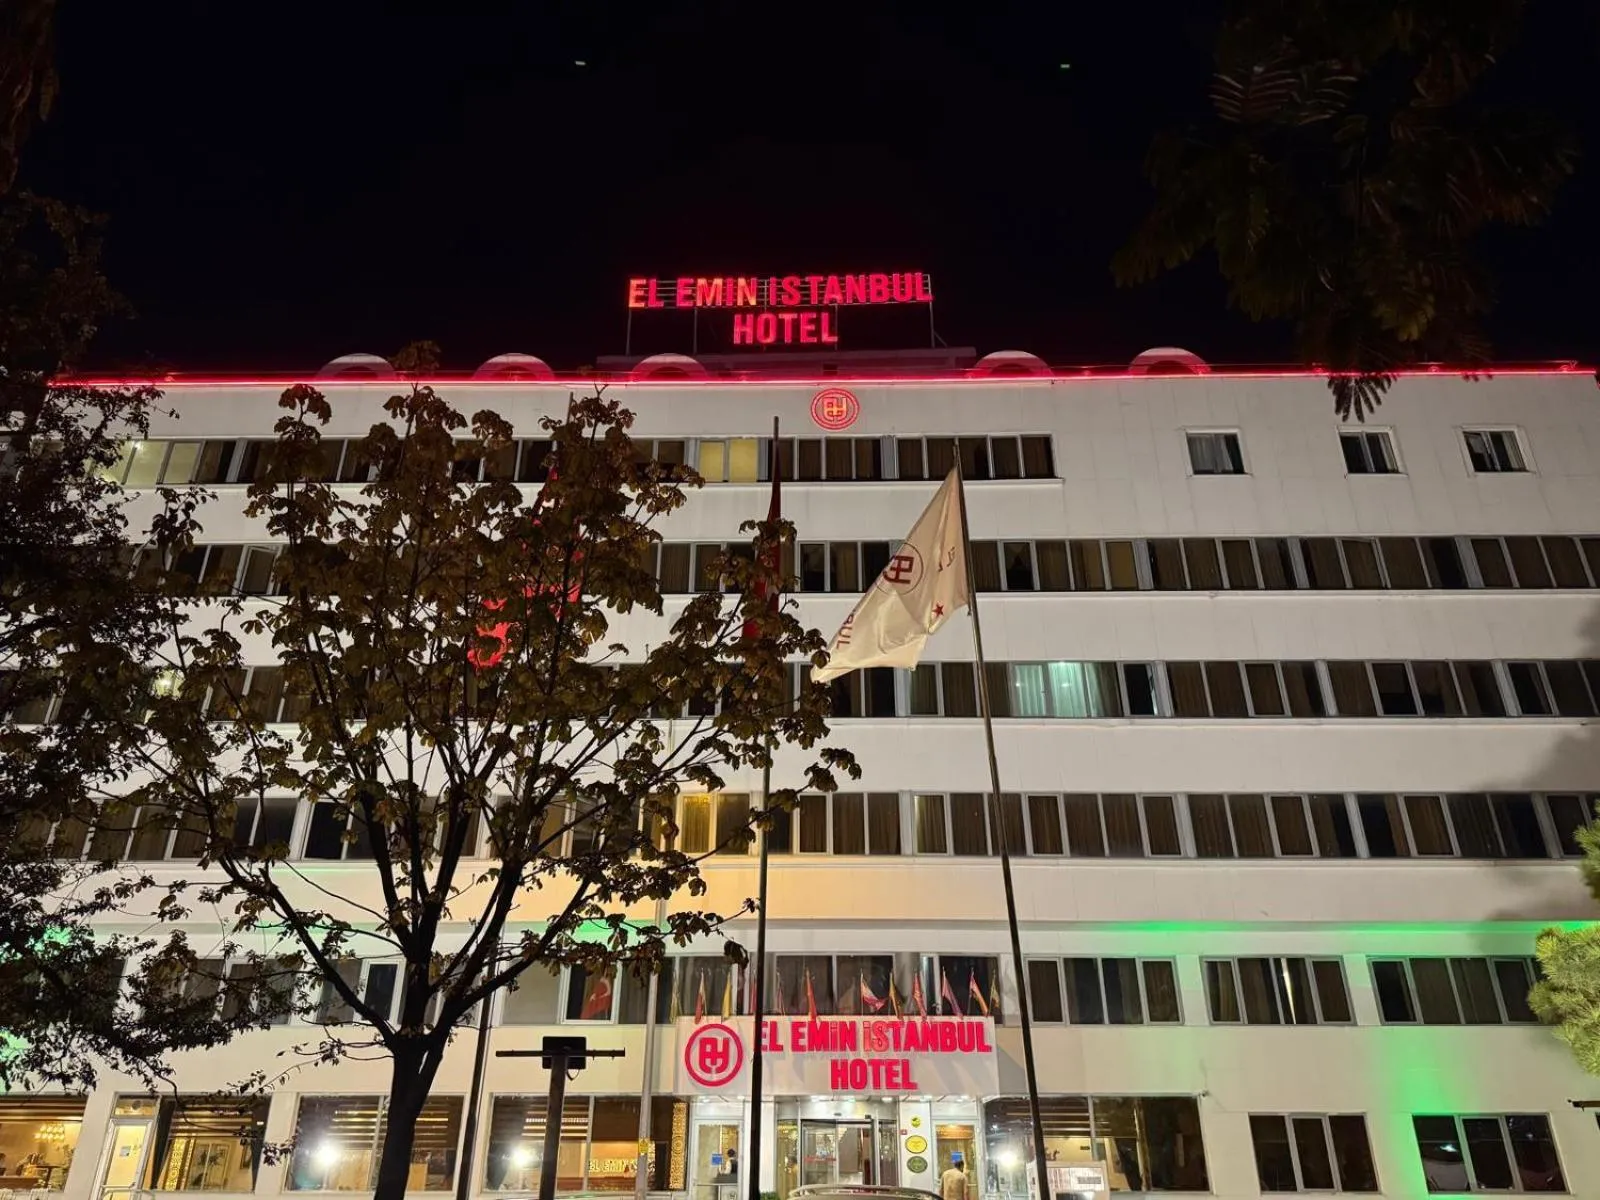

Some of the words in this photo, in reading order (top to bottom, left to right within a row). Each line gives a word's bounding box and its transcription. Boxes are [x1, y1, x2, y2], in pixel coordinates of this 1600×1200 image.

[628, 278, 664, 308] EL
[733, 312, 838, 344] HOTEL
[830, 1058, 918, 1090] HOTEL
